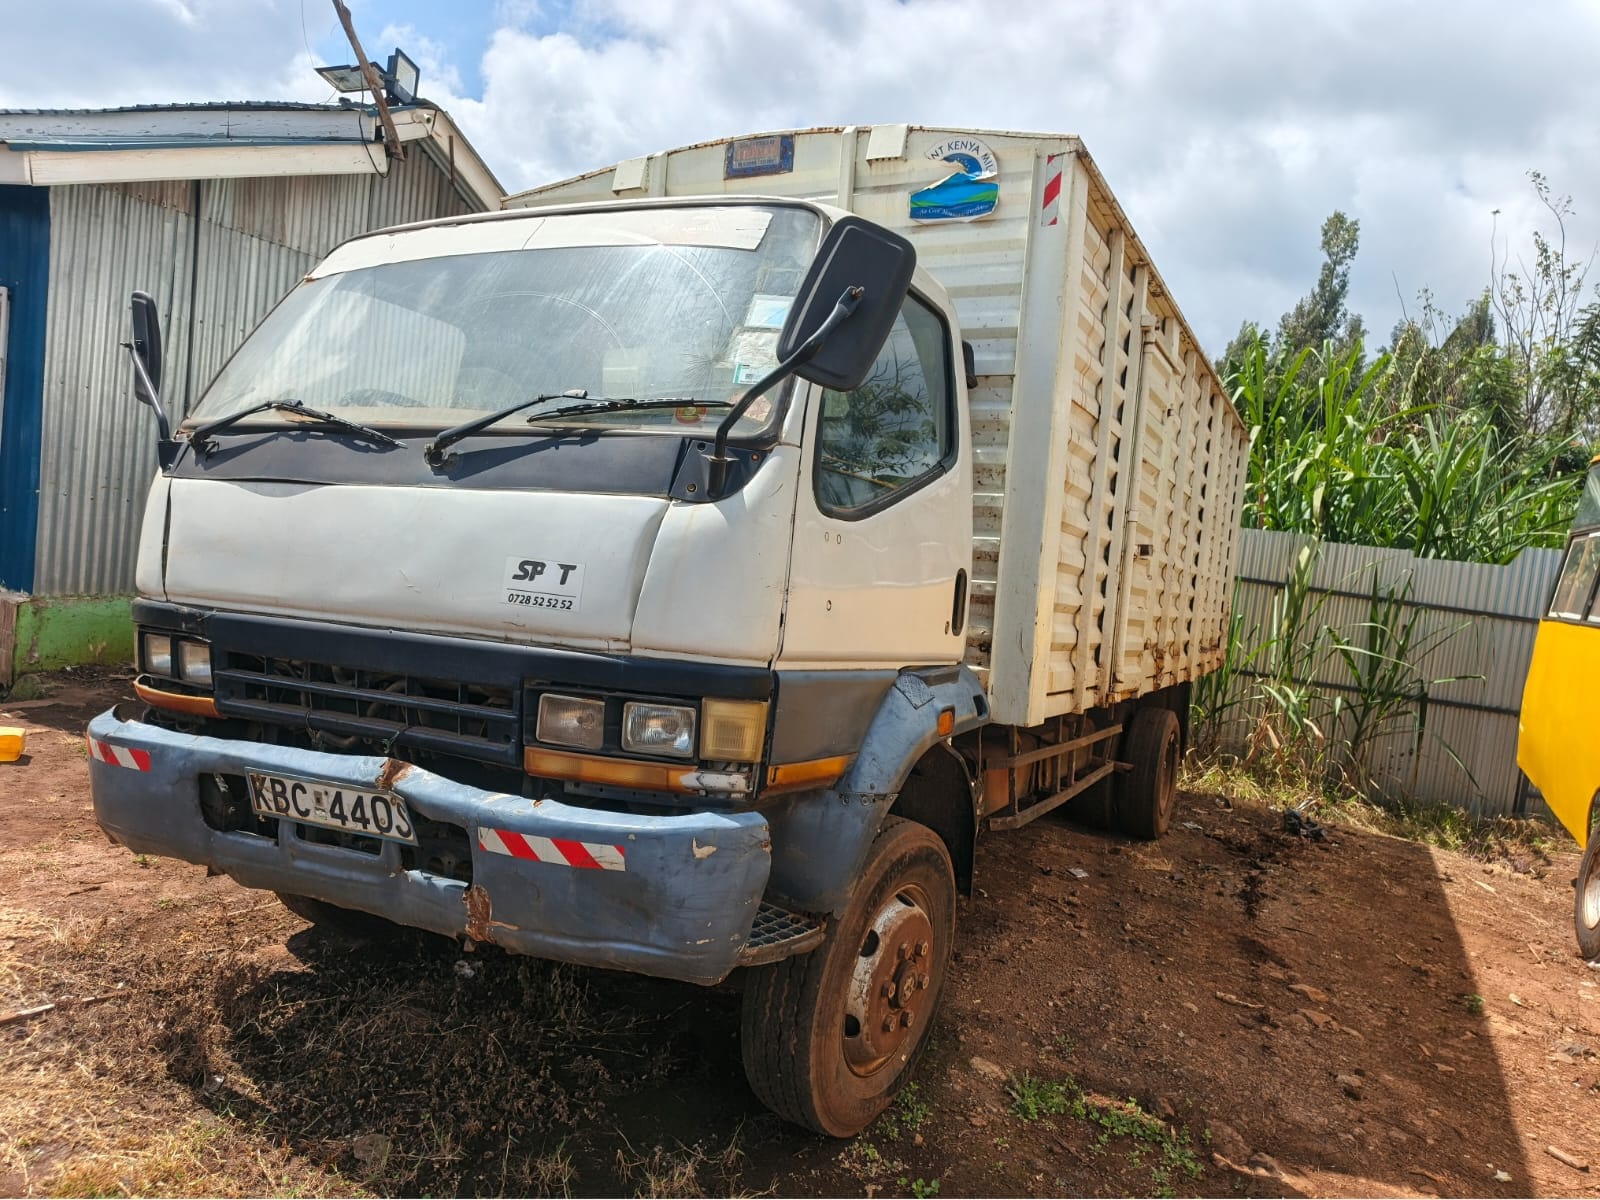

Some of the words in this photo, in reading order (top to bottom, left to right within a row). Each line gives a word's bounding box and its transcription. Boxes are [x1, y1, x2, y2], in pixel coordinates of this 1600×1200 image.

[928, 145, 944, 160] NT
[947, 140, 981, 155] KENYA
[980, 152, 995, 172] MIL
[507, 593, 532, 605] 0728
[532, 596, 545, 607] 52
[546, 598, 559, 608] 52
[560, 600, 573, 610] 52
[250, 774, 311, 818] KBC
[329, 790, 412, 838] 440S
